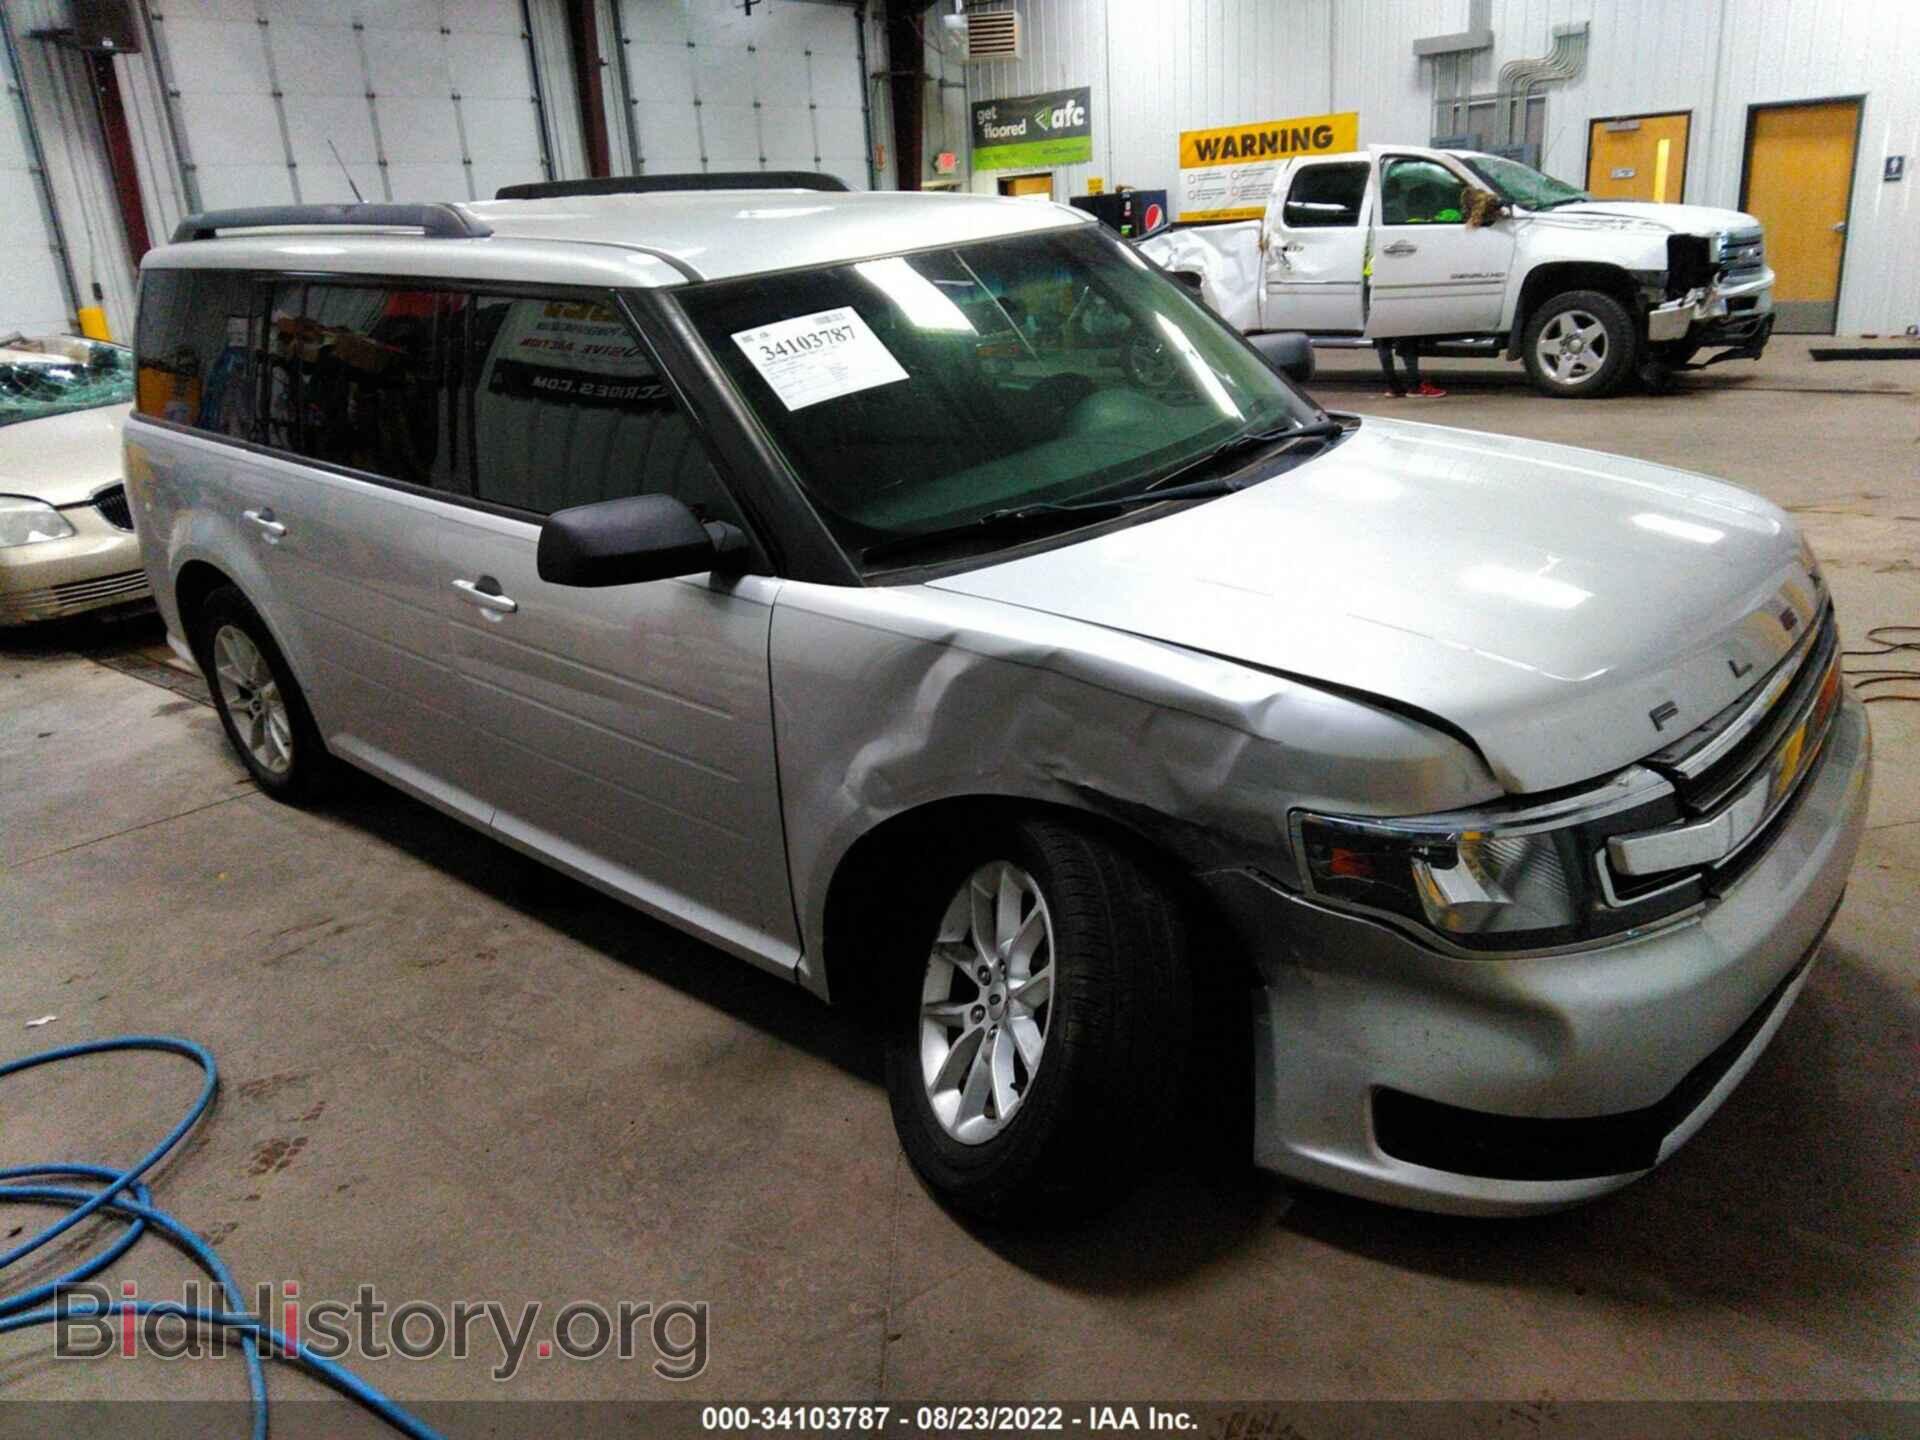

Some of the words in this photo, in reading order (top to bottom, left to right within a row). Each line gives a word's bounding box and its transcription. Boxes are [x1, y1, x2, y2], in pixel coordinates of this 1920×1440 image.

[976, 106, 998, 125] get
[984, 118, 1027, 139] floored
[1051, 99, 1085, 129] afc
[1194, 124, 1334, 162] WARNING
[759, 325, 857, 361] 34103787
